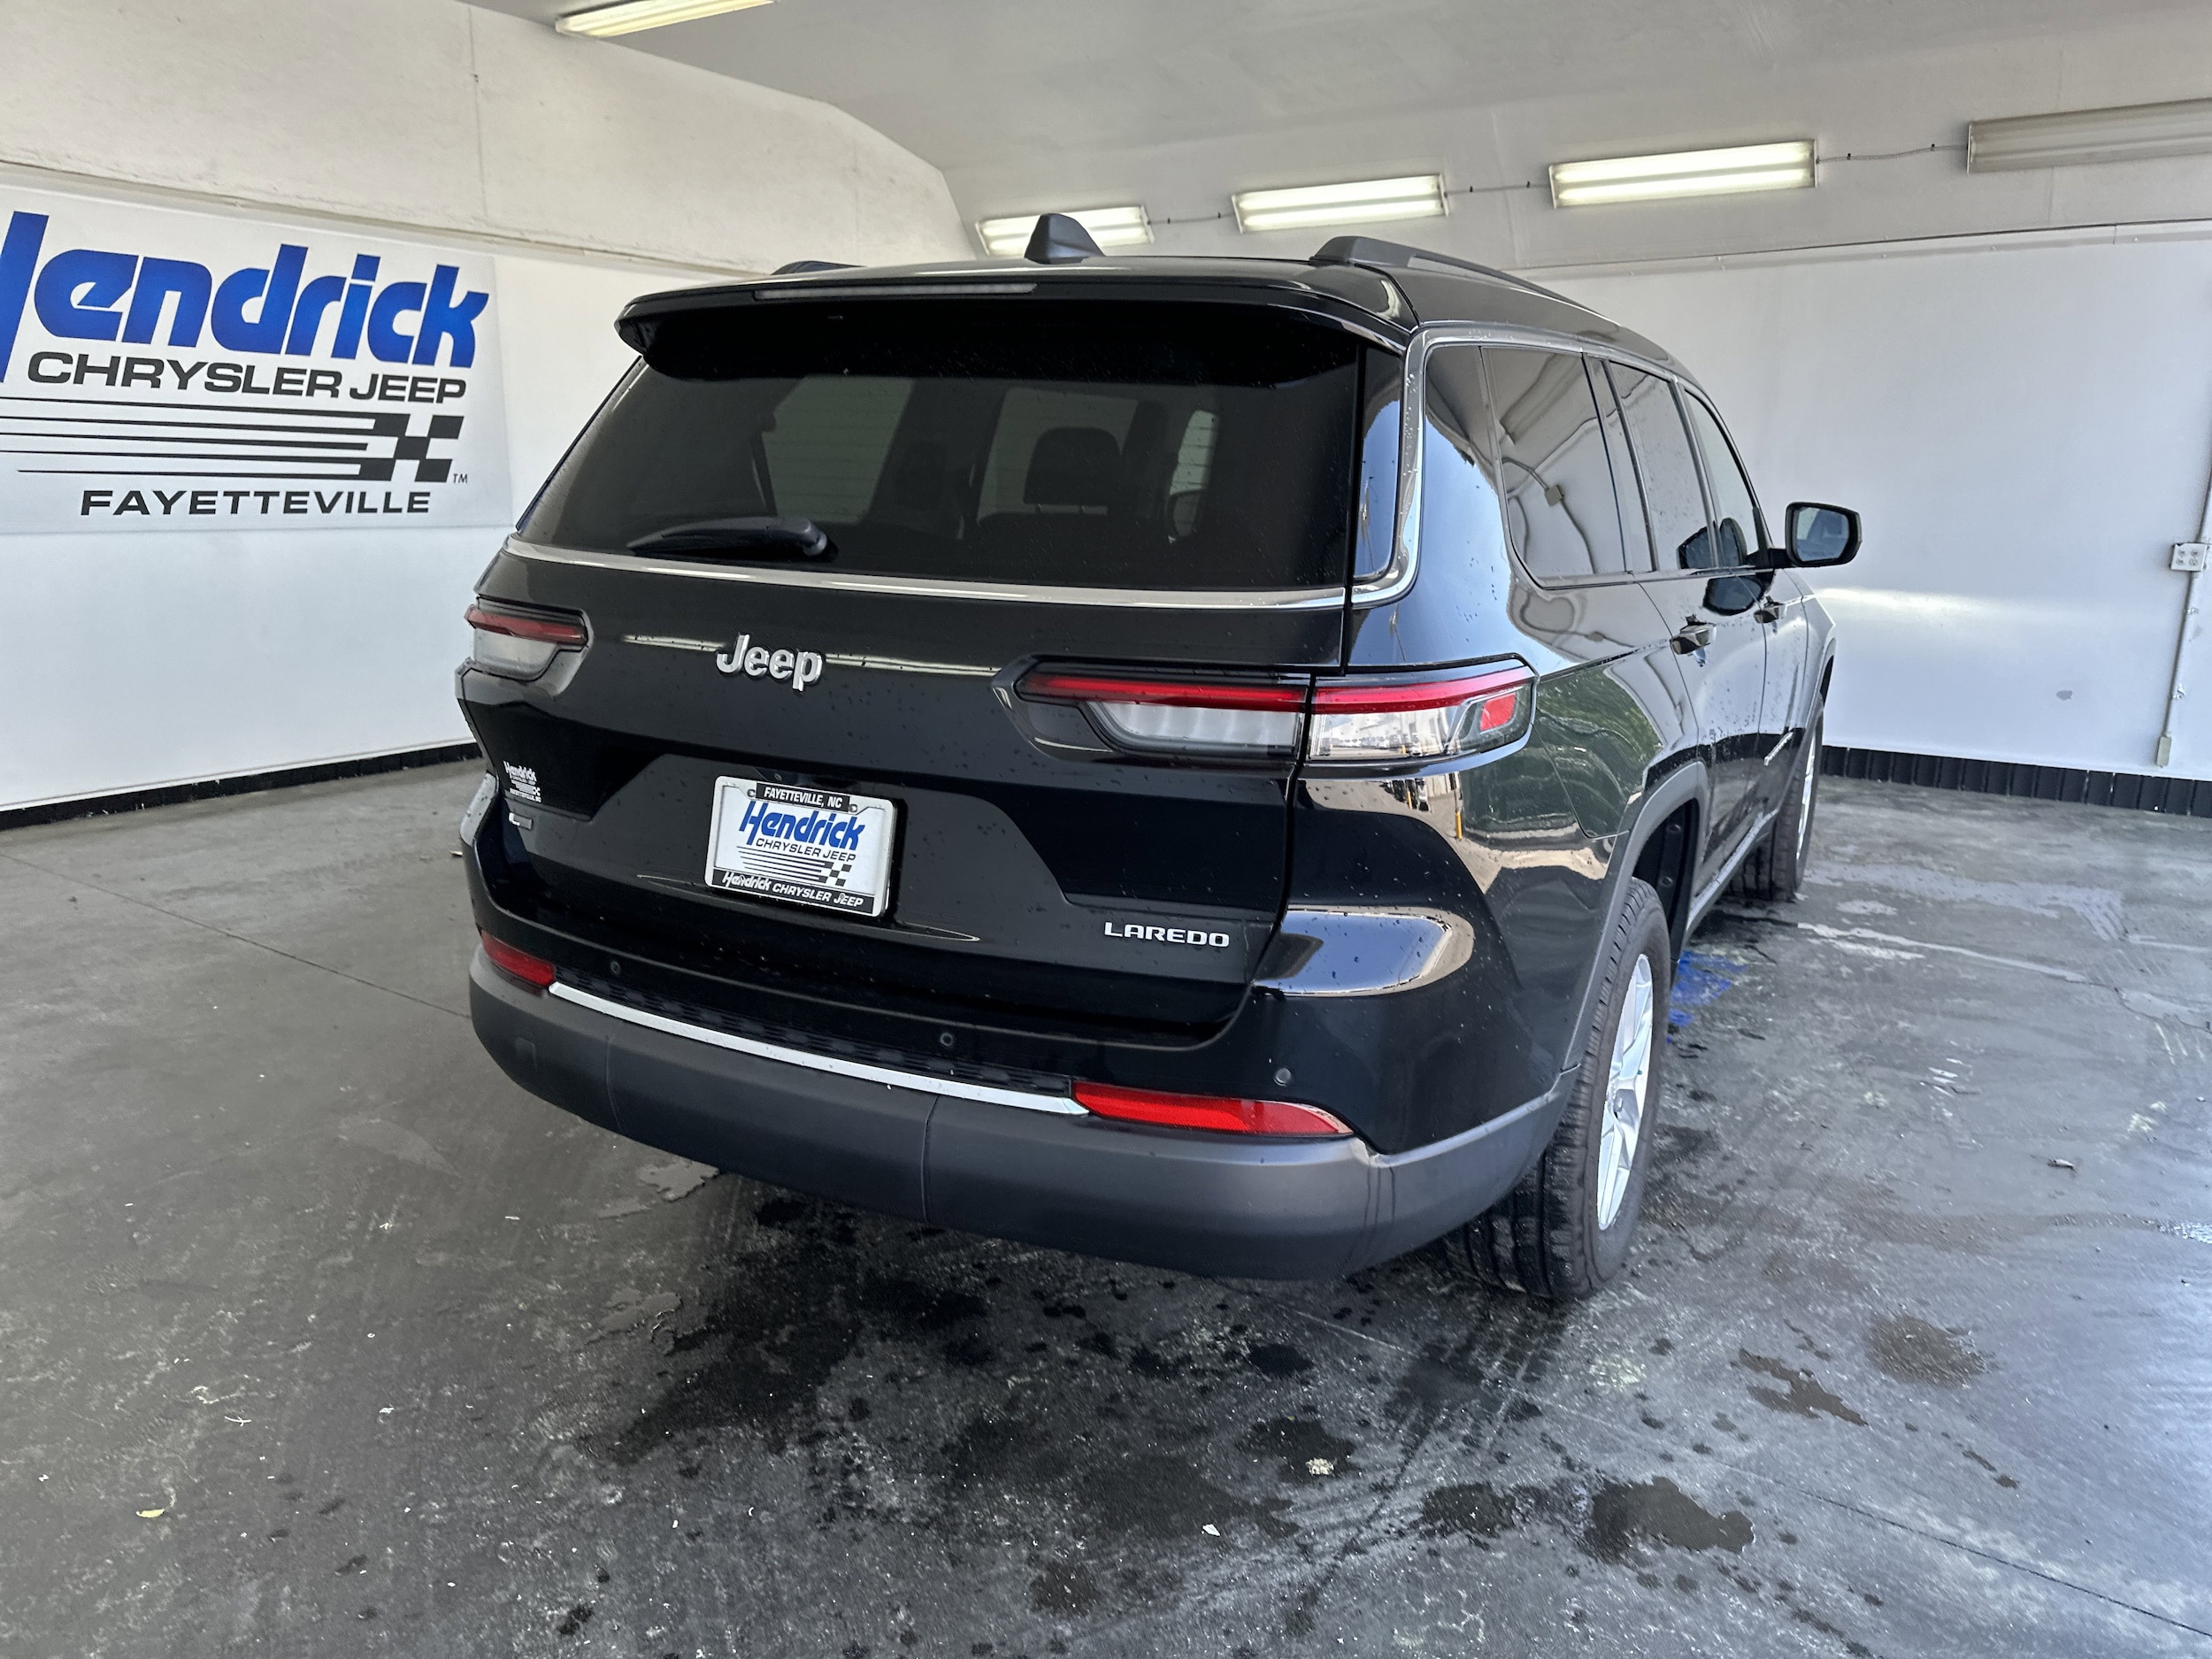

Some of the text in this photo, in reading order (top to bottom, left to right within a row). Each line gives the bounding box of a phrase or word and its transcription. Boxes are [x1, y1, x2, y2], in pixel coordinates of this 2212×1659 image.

[27, 351, 467, 403] CHRYSLER JEEP
[452, 473, 468, 484] TM
[81, 489, 431, 516] FAYETTEVILLE
[716, 634, 823, 692] Jeep
[764, 787, 843, 809] FAYETTEVILLE, NC
[739, 801, 865, 851] Hendrick
[756, 838, 856, 863] CHRYSLER JEEP
[722, 872, 864, 908] Hendrick CHRYSLER JEEP
[1104, 921, 1230, 948] LAREDO
